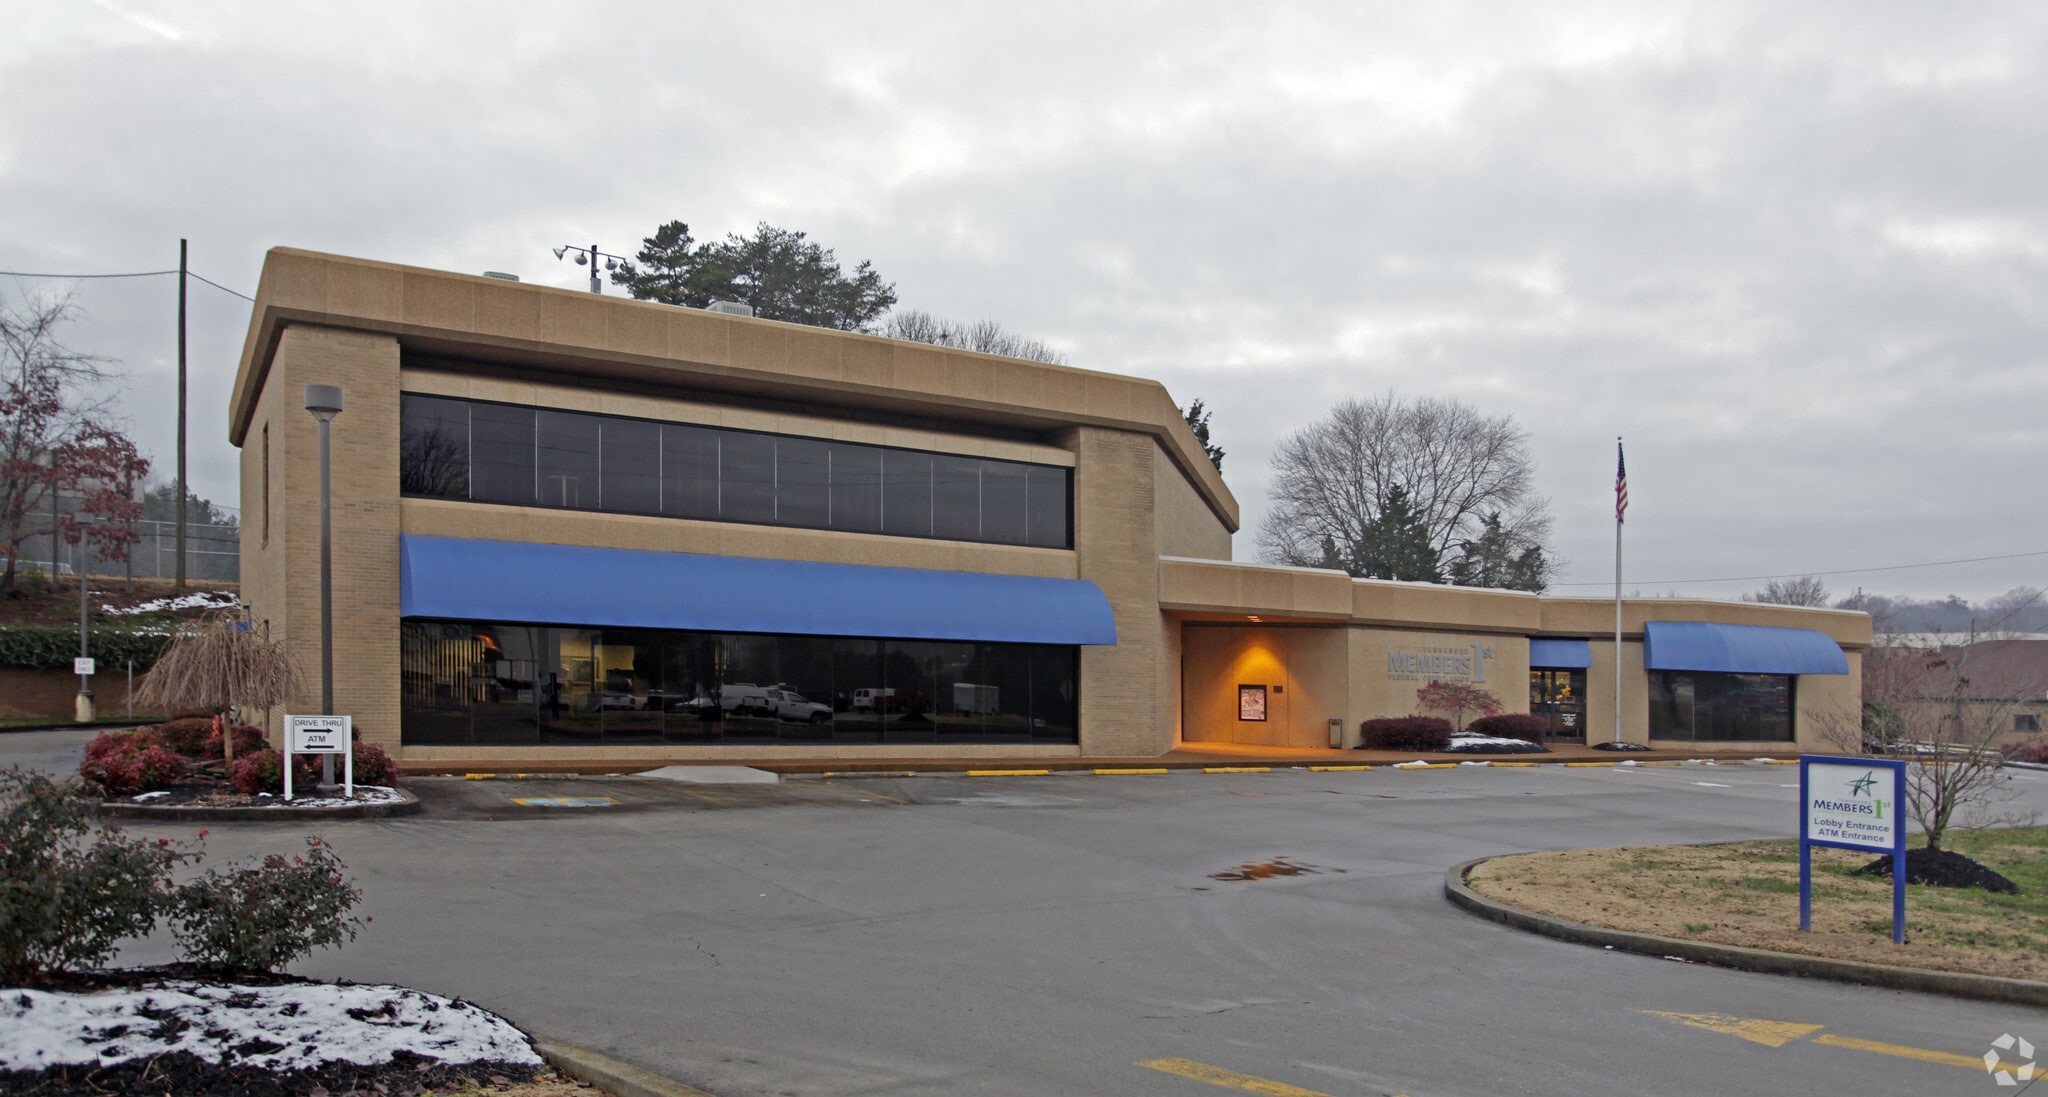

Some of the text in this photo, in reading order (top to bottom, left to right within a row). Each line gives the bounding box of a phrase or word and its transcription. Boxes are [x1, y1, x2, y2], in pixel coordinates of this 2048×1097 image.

[1388, 650, 1472, 675] MEMBERS
[1813, 800, 1873, 814] MEMBERS
[1814, 817, 1889, 832] Lobby Entrance
[1818, 828, 1885, 843] ATM Entrance
